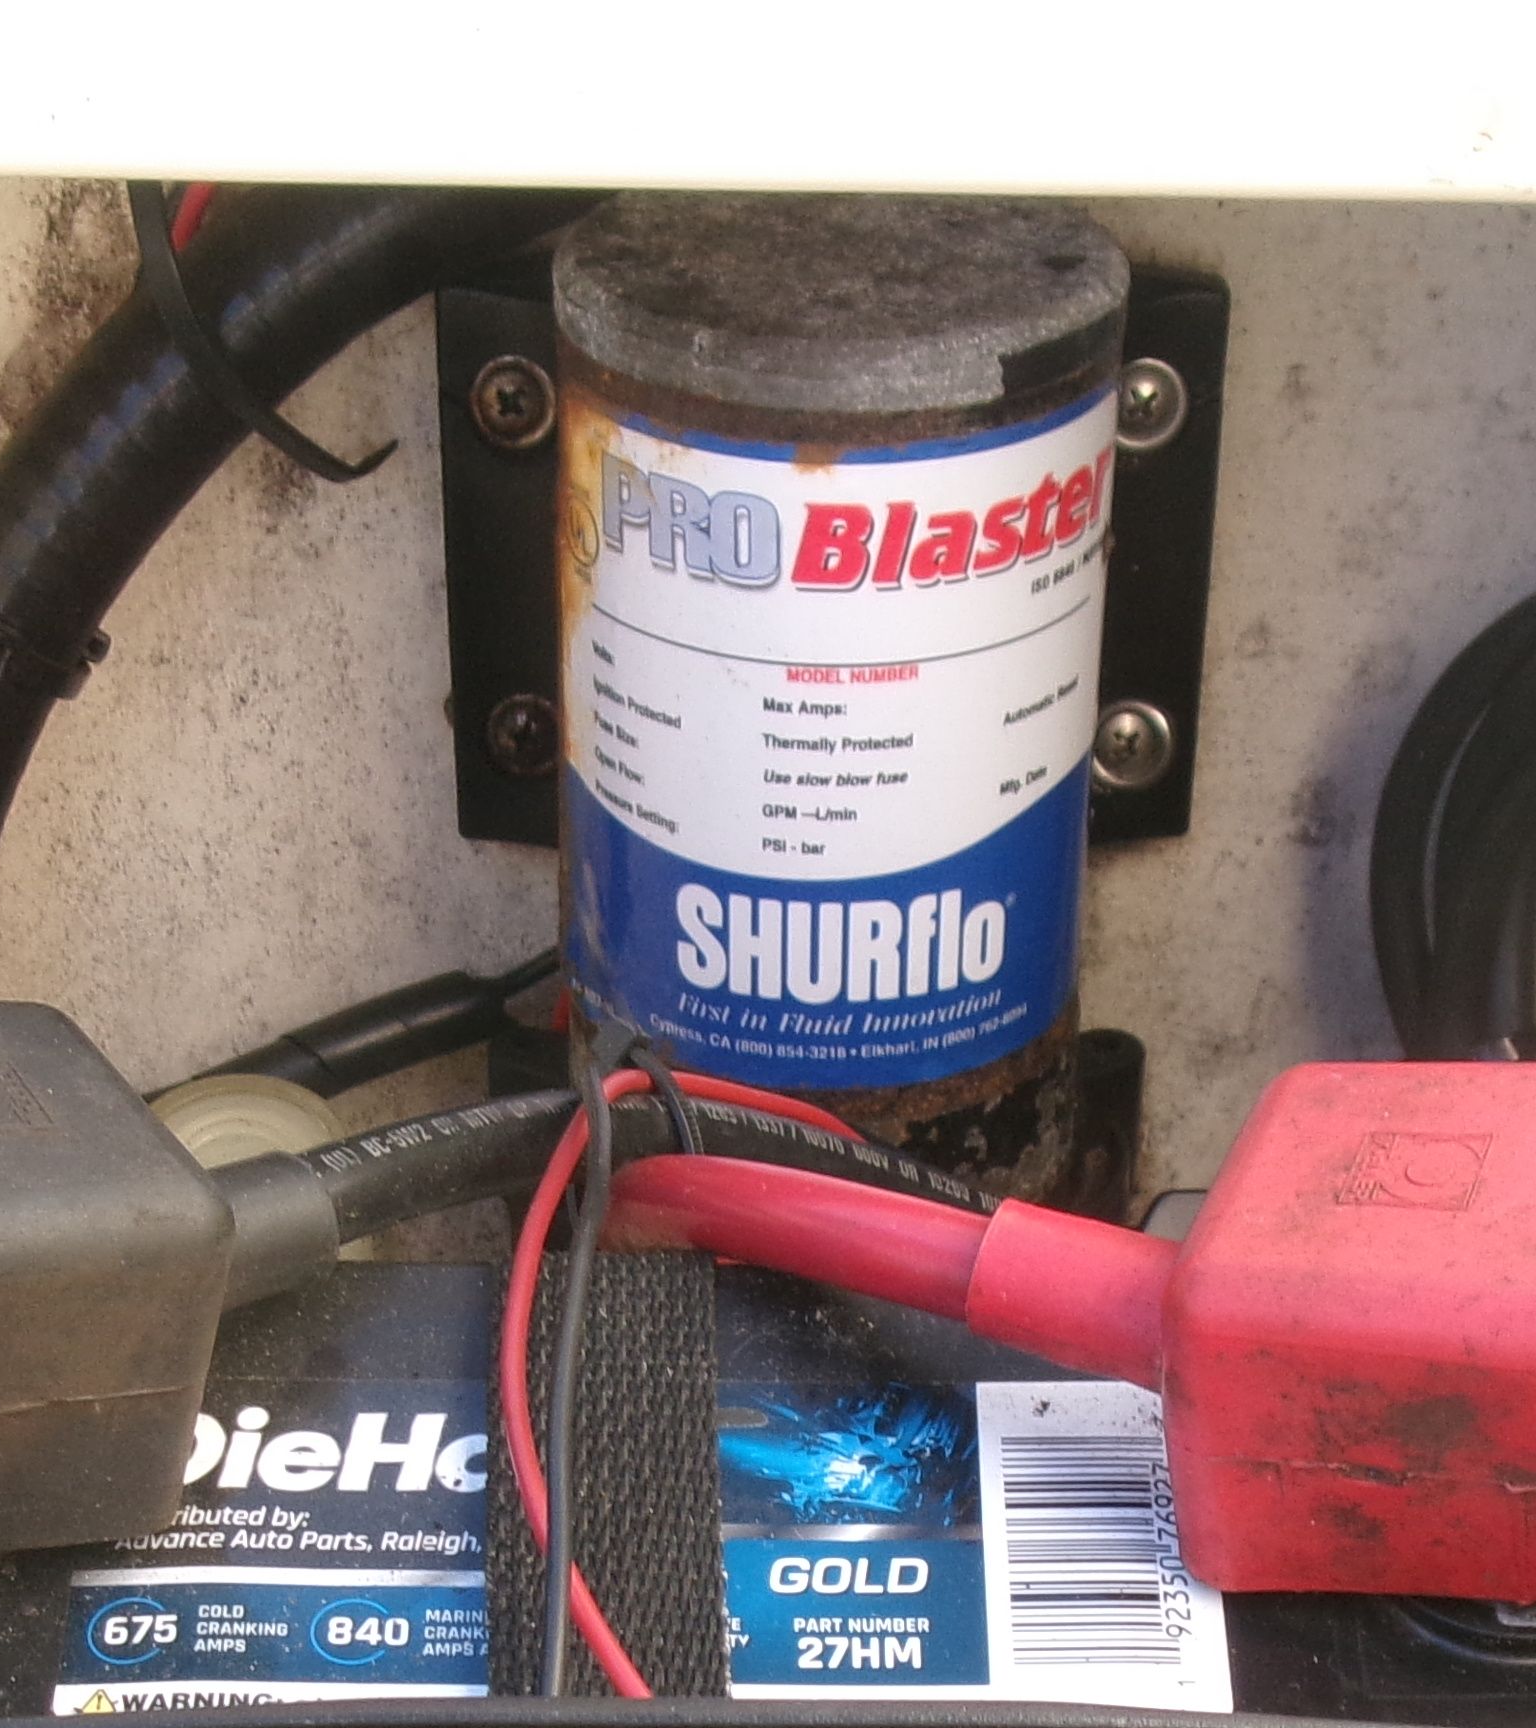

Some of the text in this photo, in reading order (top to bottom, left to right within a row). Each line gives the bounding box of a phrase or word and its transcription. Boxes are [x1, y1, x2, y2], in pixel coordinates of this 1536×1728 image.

[602, 453, 781, 589] PRO
[789, 448, 1114, 590] Blaster
[786, 665, 918, 683] MODEL NUMBER
[627, 696, 681, 729] Protected
[763, 697, 847, 718] Max Amps:
[1003, 693, 1054, 726] Automatic
[762, 733, 913, 754] Thermally Protected
[764, 769, 908, 787] Use slow blow fuse
[595, 779, 633, 813] Pressure
[762, 804, 797, 819] GPM
[762, 838, 786, 853] PSI
[801, 841, 825, 855] bar
[675, 883, 1008, 1003] SHURflo
[678, 992, 731, 1024] First
[740, 1008, 768, 1030] in
[779, 1013, 854, 1035] Fluid
[863, 988, 1002, 1034] Innovation
[710, 1033, 731, 1049] CA
[735, 1040, 772, 1058] (800)
[923, 1036, 939, 1050] IN
[942, 1026, 975, 1047] (800)
[170, 1505, 311, 1531] ributed by:
[230, 1529, 293, 1550] Auto
[299, 1530, 372, 1553] Parts,
[381, 1530, 483, 1555] Raleigh,
[769, 1557, 930, 1594] GOLD
[1159, 1555, 1192, 1638] 92350
[198, 1605, 245, 1618] COLD
[103, 1615, 177, 1645] 675
[196, 1622, 288, 1637] CRANKING
[327, 1616, 409, 1645] 840
[794, 1618, 930, 1634] PART NUMBER
[194, 1638, 246, 1653] AMPS
[423, 1641, 474, 1657] AMPS
[797, 1637, 923, 1669] 27HM
